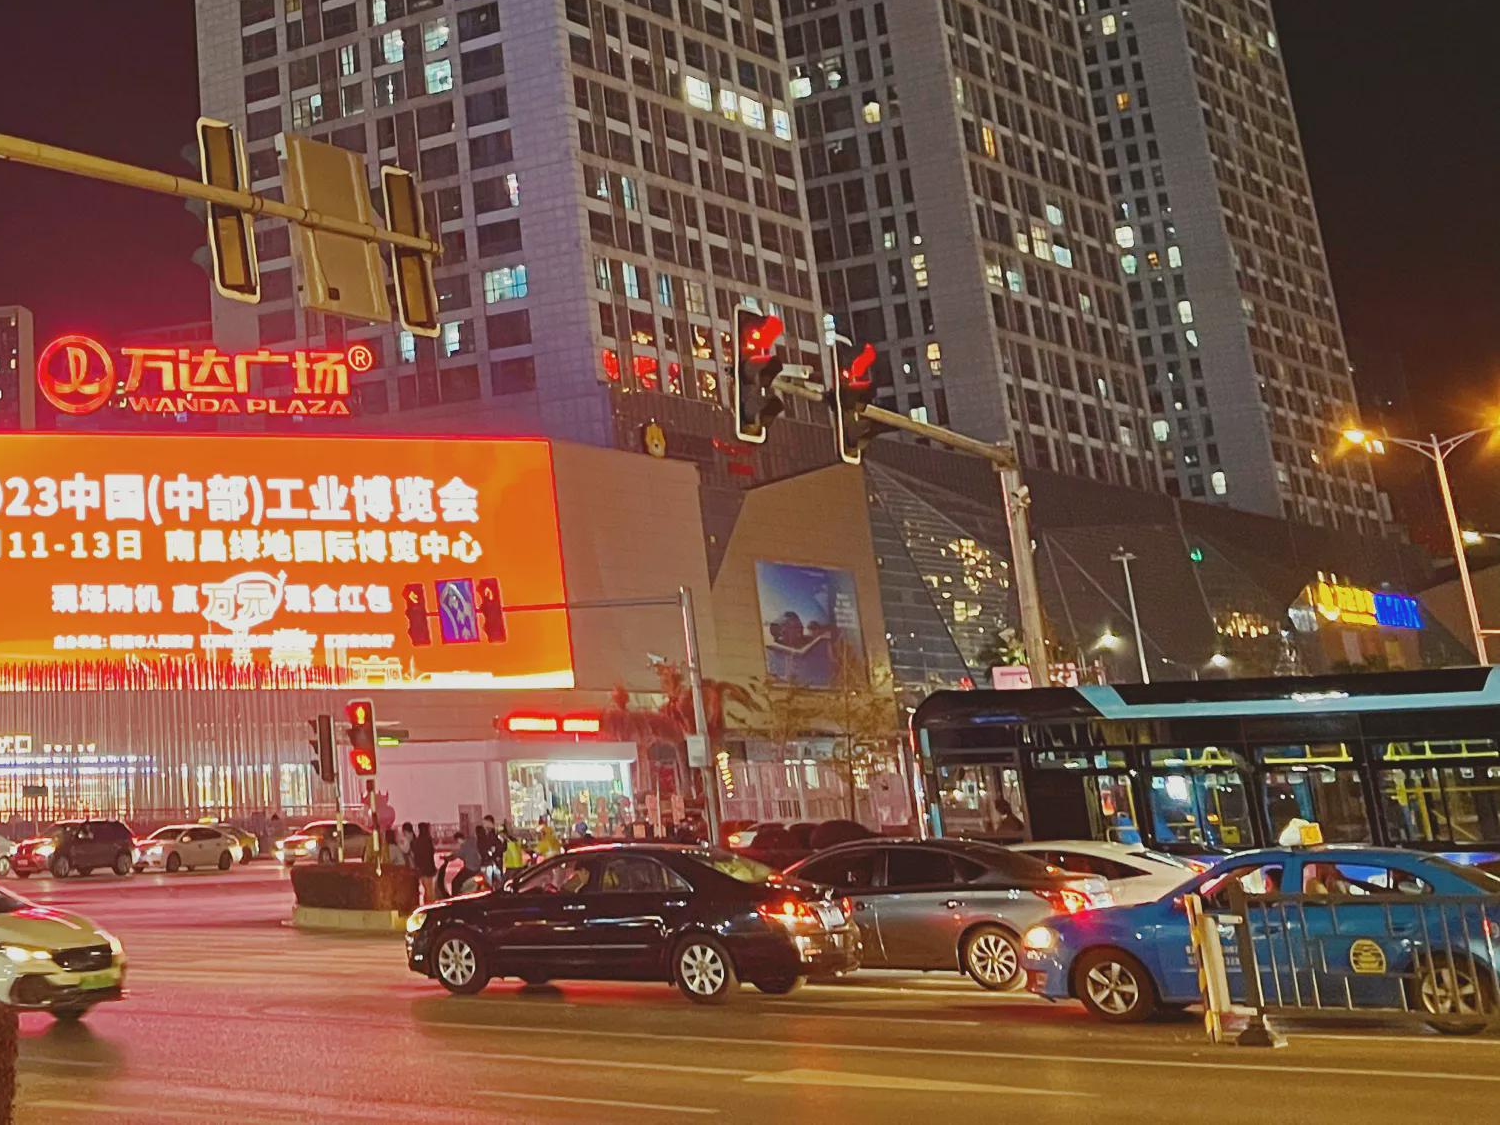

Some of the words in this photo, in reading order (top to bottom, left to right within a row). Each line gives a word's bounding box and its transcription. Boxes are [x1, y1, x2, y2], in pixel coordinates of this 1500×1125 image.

[121, 348, 349, 394] 万达广场
[128, 397, 240, 413] WANDA
[246, 399, 350, 415] PLAZA
